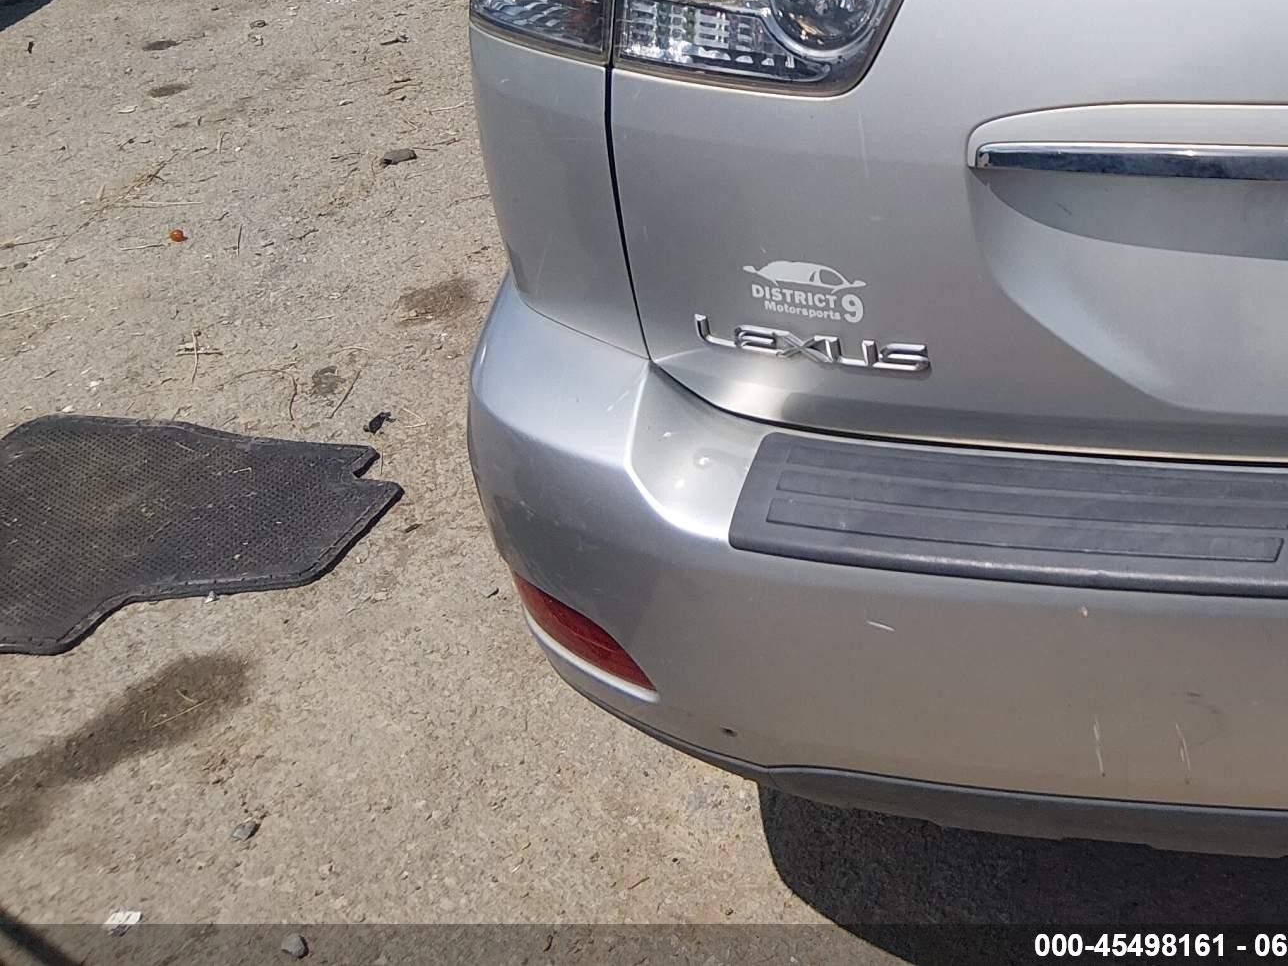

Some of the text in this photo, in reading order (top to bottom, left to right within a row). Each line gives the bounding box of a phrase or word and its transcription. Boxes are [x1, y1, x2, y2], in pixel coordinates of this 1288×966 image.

[751, 284, 864, 324] DISTRICT 9
[764, 300, 841, 320] Motorsports
[694, 312, 931, 372] LEXUS
